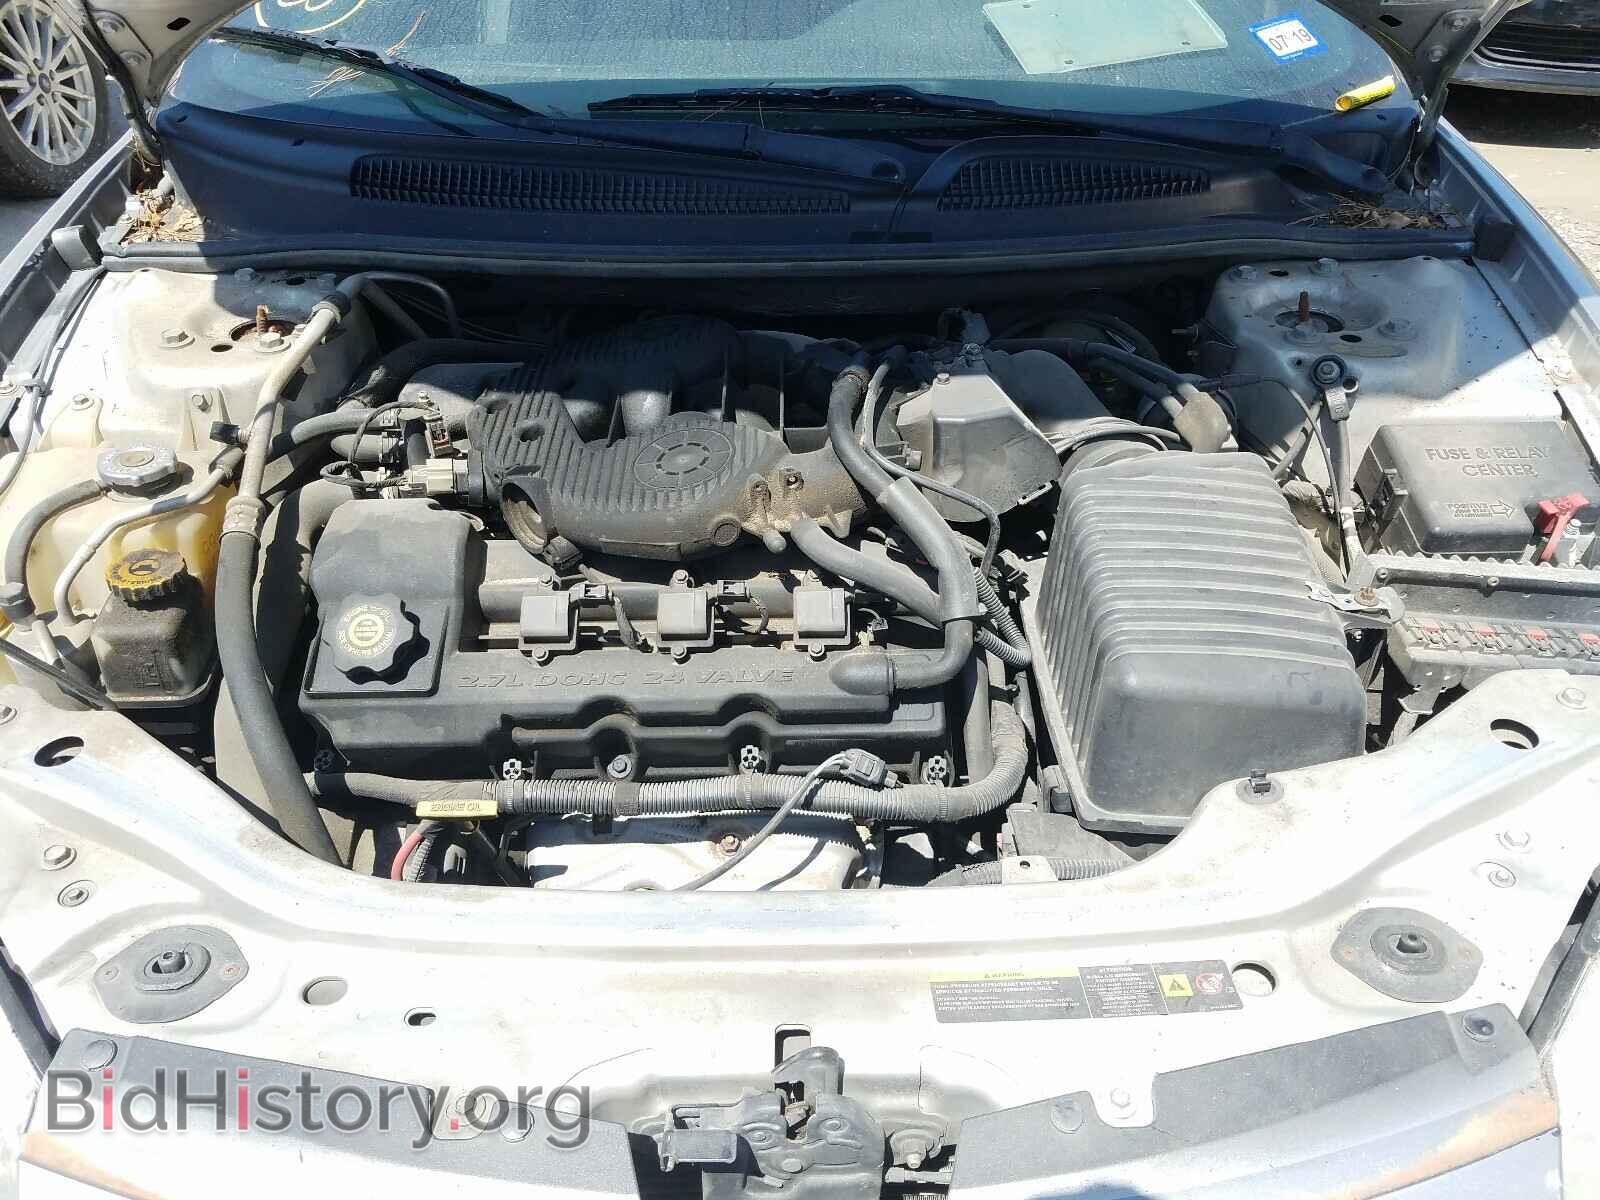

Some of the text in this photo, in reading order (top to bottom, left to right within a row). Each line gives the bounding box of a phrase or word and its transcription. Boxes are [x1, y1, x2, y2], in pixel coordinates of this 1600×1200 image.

[1268, 29, 1312, 51] 07 19
[1424, 446, 1552, 460] FUSE & RELAY
[1462, 463, 1538, 478] CENTER
[457, 668, 795, 688] 2.7L DOHC 24 VALVE
